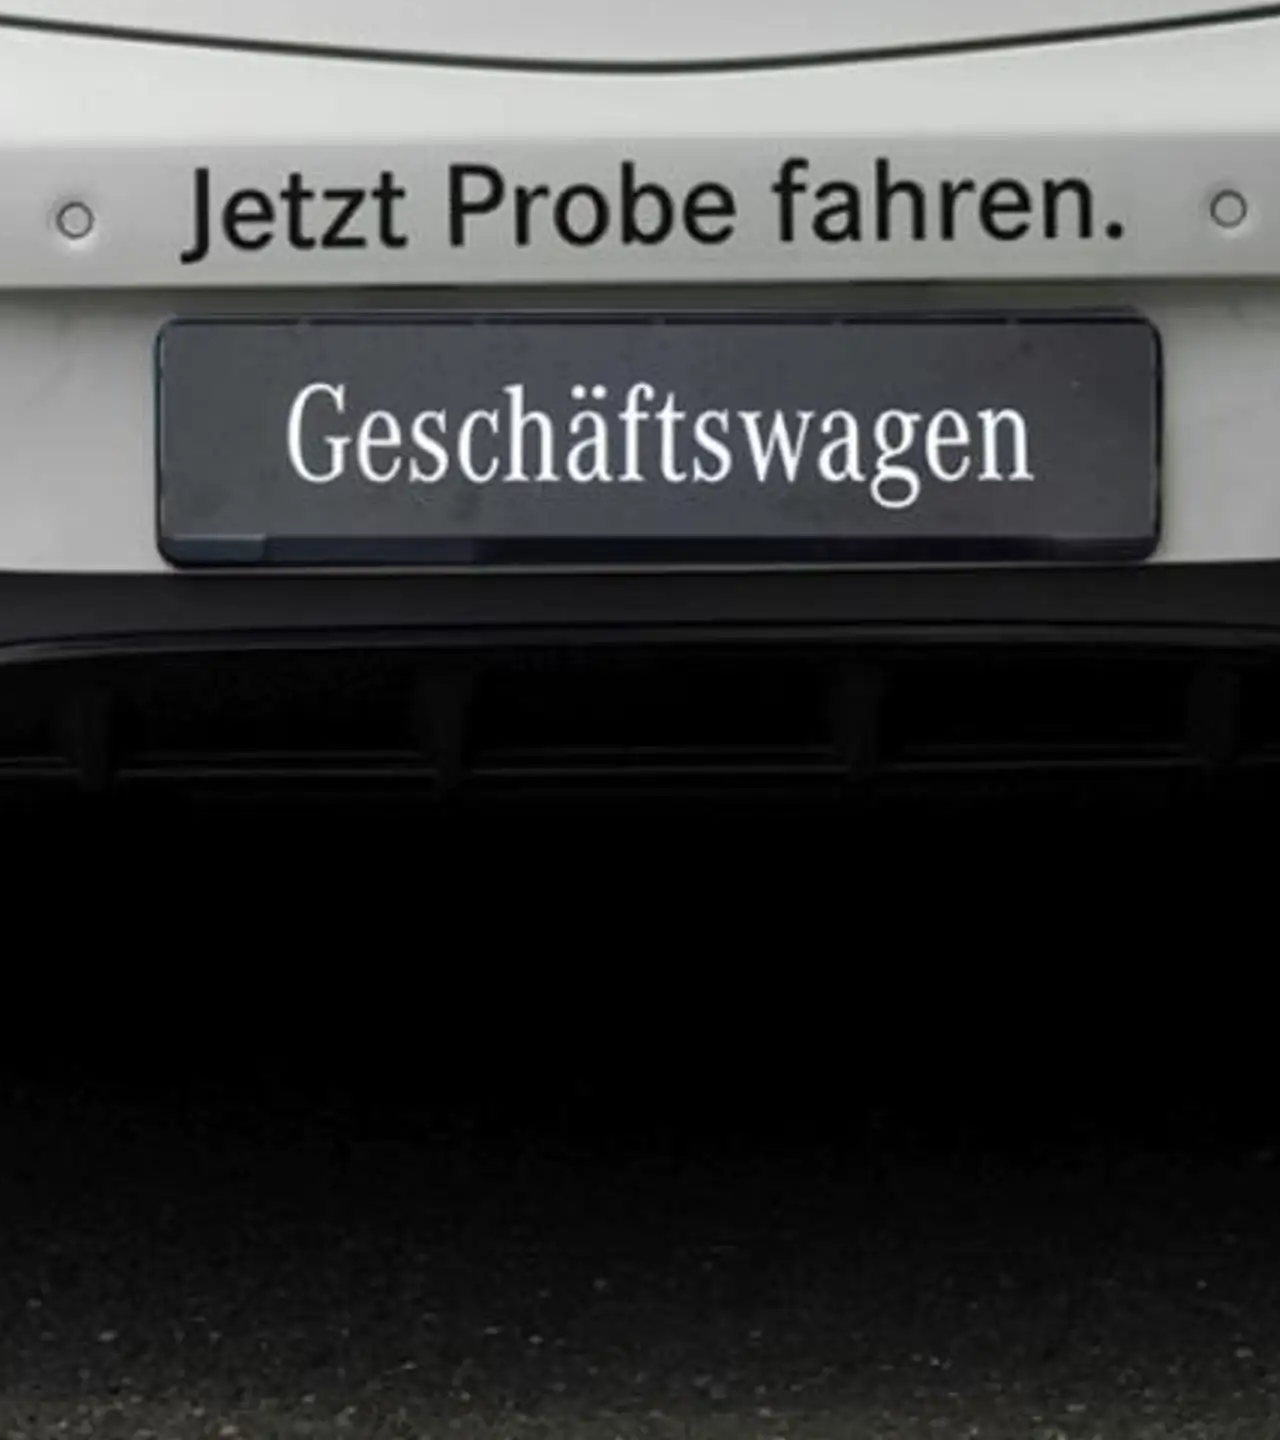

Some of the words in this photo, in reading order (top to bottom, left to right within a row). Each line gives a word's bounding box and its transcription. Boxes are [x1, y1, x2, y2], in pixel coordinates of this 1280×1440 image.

[179, 166, 410, 266] Jetzt
[447, 159, 738, 249] Probe
[769, 156, 1125, 245] fahren.
[285, 380, 1035, 510] Geschäftswagen
